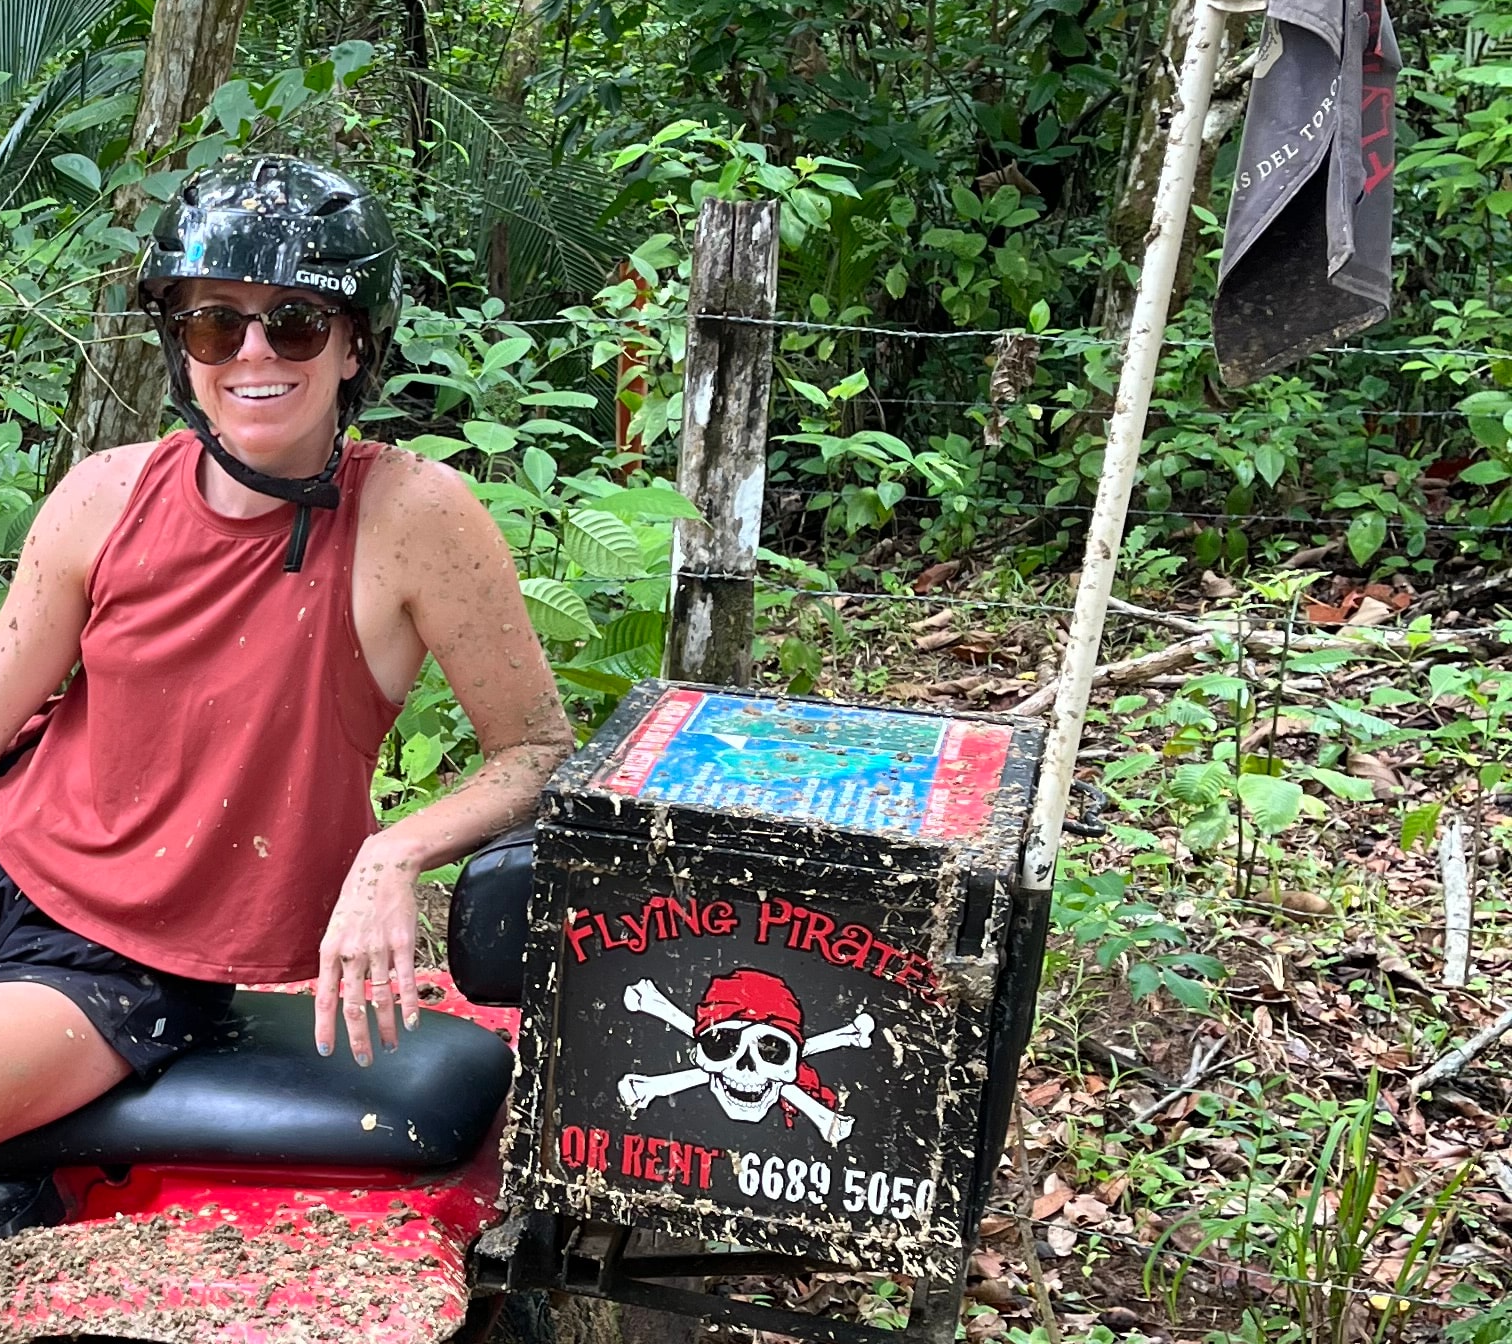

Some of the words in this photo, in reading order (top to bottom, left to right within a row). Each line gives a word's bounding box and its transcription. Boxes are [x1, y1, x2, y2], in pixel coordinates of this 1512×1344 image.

[1256, 143, 1299, 182] DEL
[296, 270, 340, 291] GIRO
[621, 1134, 719, 1190] RENT
[738, 1152, 831, 1205] 6689
[842, 1168, 936, 1220] 5050
